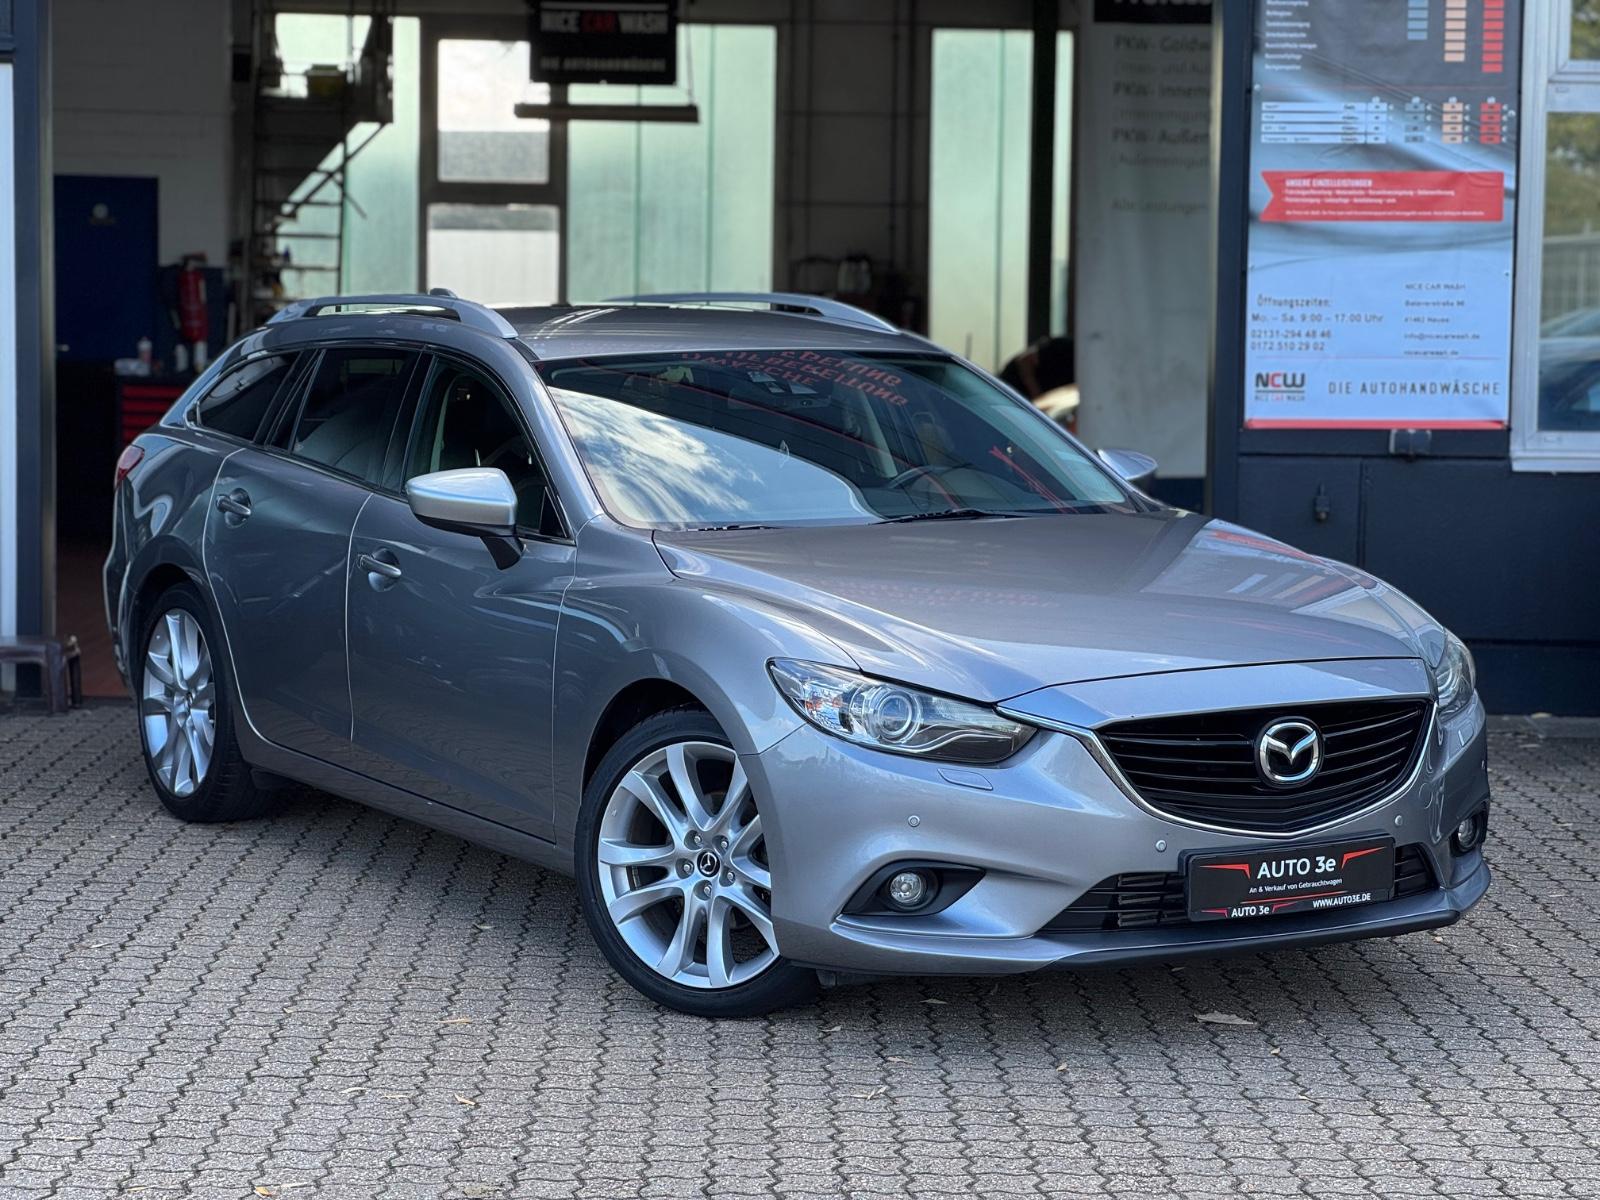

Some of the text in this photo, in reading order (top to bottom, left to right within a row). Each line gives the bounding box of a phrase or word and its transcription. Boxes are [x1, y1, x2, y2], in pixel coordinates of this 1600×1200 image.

[1364, 313, 1384, 322] Uhr
[1255, 373, 1305, 388] NCW
[1328, 379, 1500, 395] DIE AUTOHANDWÄSCHE
[1257, 856, 1337, 880] AUTO 3e
[1264, 883, 1287, 892] Verkauf
[1287, 882, 1298, 890] von
[1298, 878, 1343, 889] Gebrauchtwagen
[1312, 892, 1372, 909] WWW.AUTO3E.DE
[1231, 905, 1270, 918] AUTO 3e
